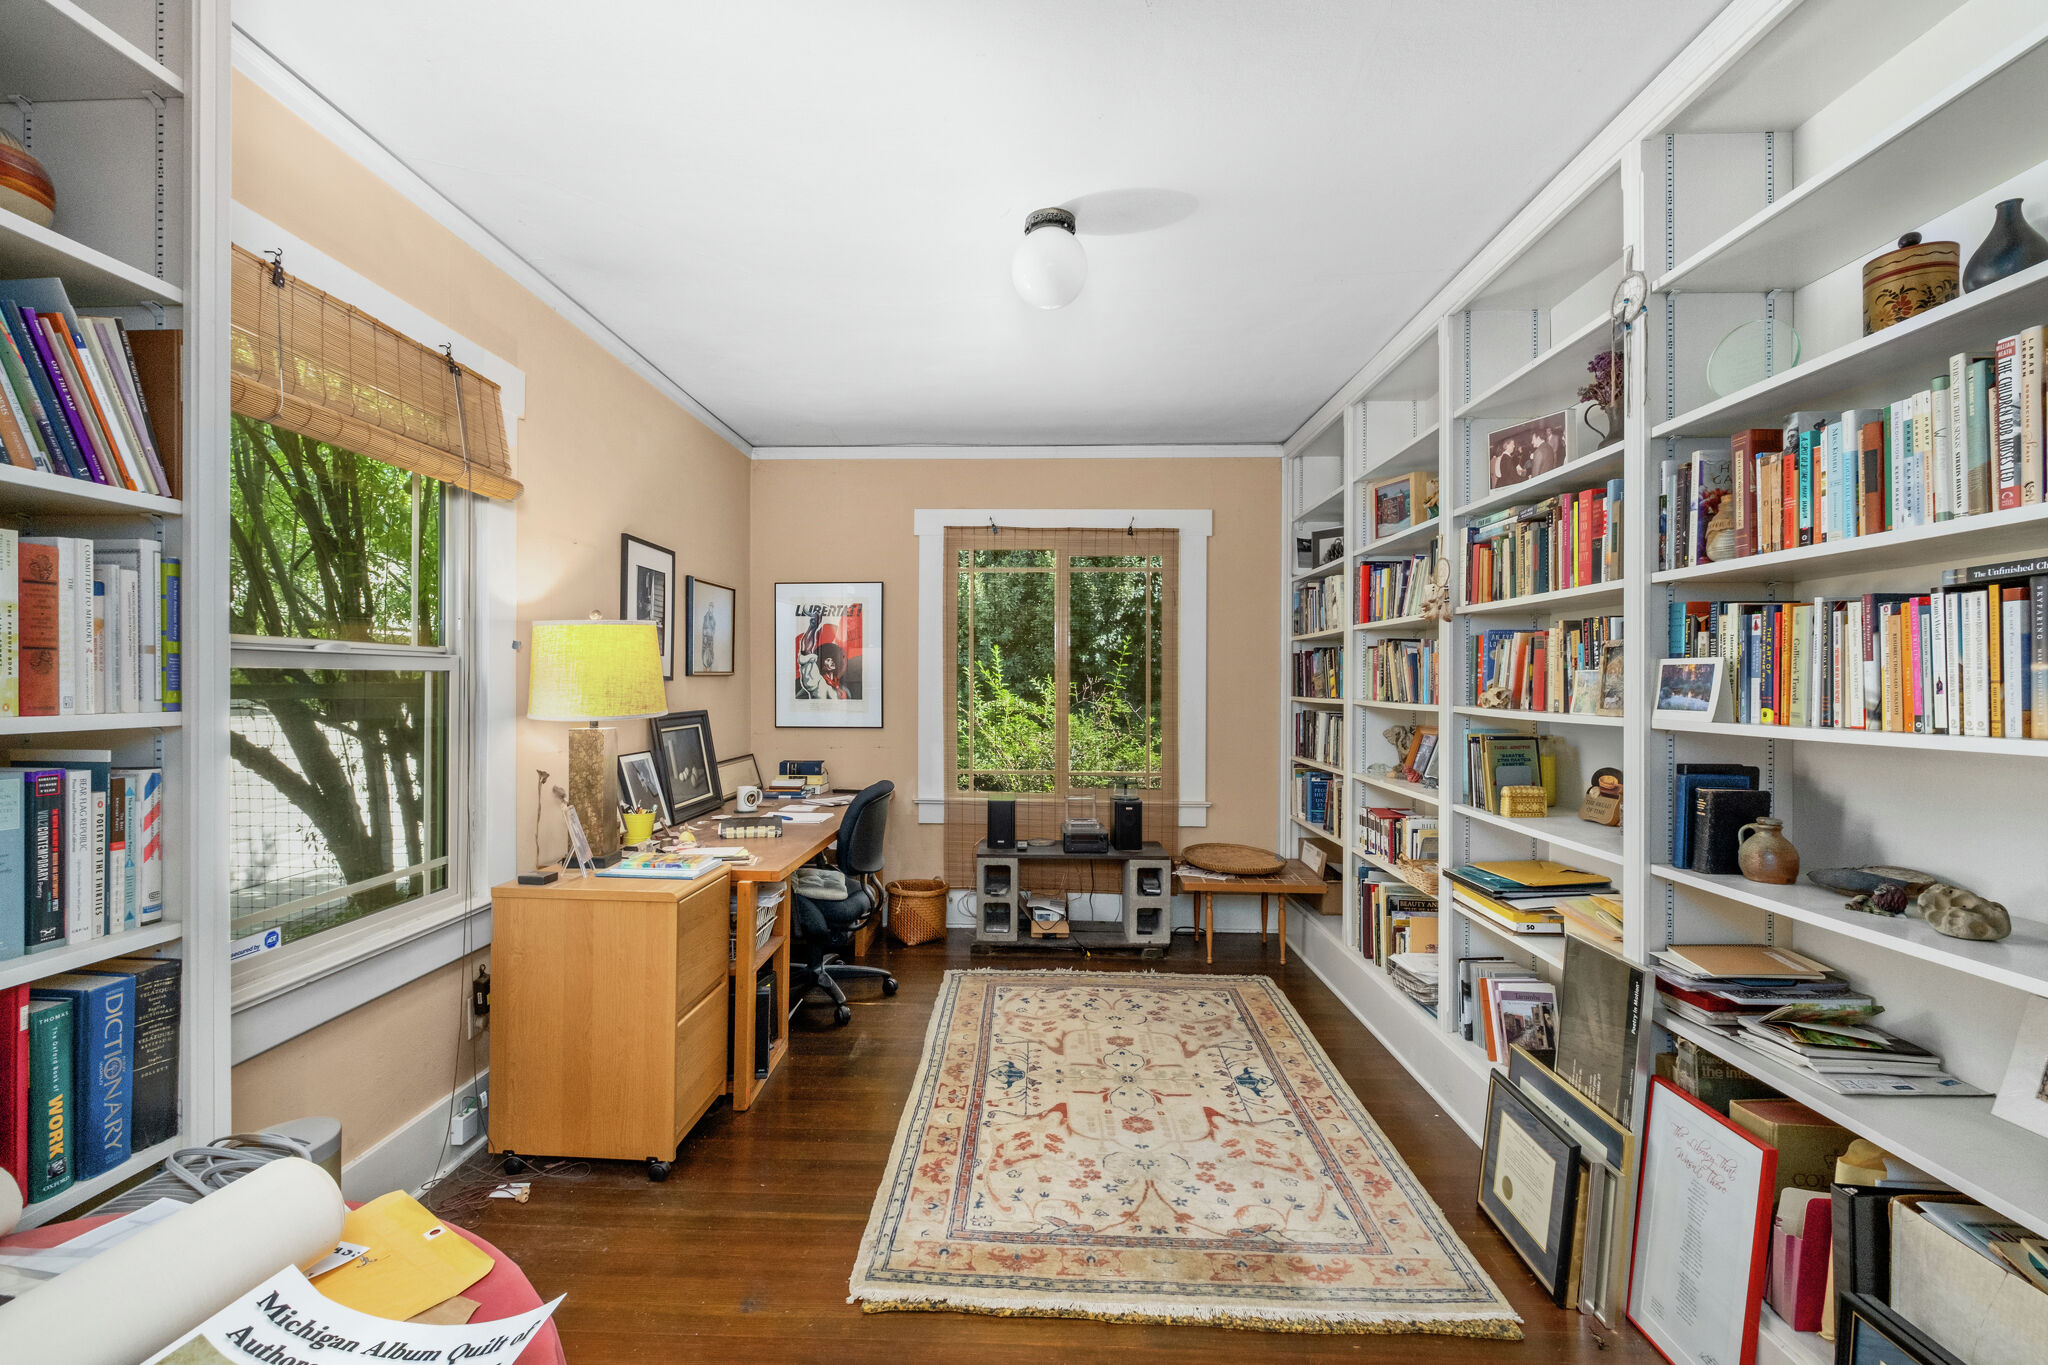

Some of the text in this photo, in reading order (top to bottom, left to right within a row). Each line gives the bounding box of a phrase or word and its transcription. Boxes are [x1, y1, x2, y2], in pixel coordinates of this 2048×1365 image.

[51, 360, 76, 411] OFF THE MAP
[1952, 360, 1960, 384] WHEN
[1998, 358, 2015, 482] THE CHILDREN BOB MOSES LED
[1953, 427, 1961, 449] SINGS
[84, 544, 92, 593] COMMITTED
[1987, 562, 2034, 576] Unfinished
[85, 596, 92, 607] TO
[1766, 664, 1771, 675] OF
[79, 819, 87, 851] REPUBLIC
[96, 813, 104, 844] POETRY
[37, 827, 49, 881] CONTEMPORARY
[96, 847, 104, 856] OF
[35, 881, 43, 898] Poetry
[95, 878, 103, 916] THIRTIES
[39, 1011, 70, 1025] THOMAS
[103, 992, 124, 1150] DICTIONARY
[1702, 1065, 1724, 1078] the
[48, 1093, 64, 1160] WORK
[43, 1175, 70, 1192] OXFORD
[257, 1290, 541, 1363] Michigan Album Quilt of
[226, 1325, 319, 1365] Autho
